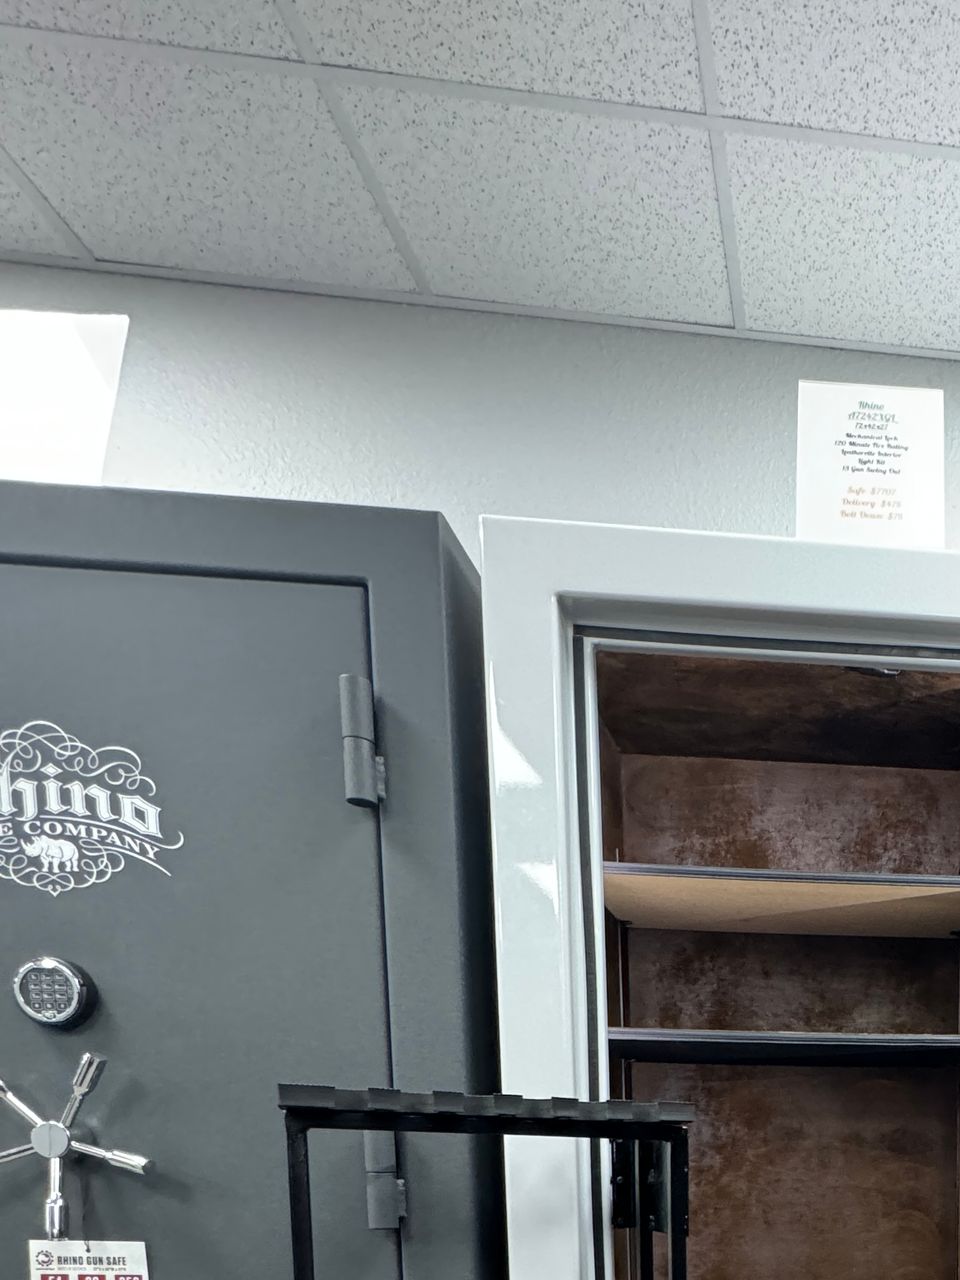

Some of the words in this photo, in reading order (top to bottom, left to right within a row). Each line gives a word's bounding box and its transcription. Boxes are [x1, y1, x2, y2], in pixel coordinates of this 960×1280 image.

[858, 400, 885, 410] Rhino
[841, 498, 877, 509] Delivery
[0, 757, 163, 838] hino
[23, 820, 160, 860] COMPANY
[57, 1255, 84, 1266] RHINO
[86, 1256, 104, 1266] GUN
[106, 1256, 127, 1266] SAFE
